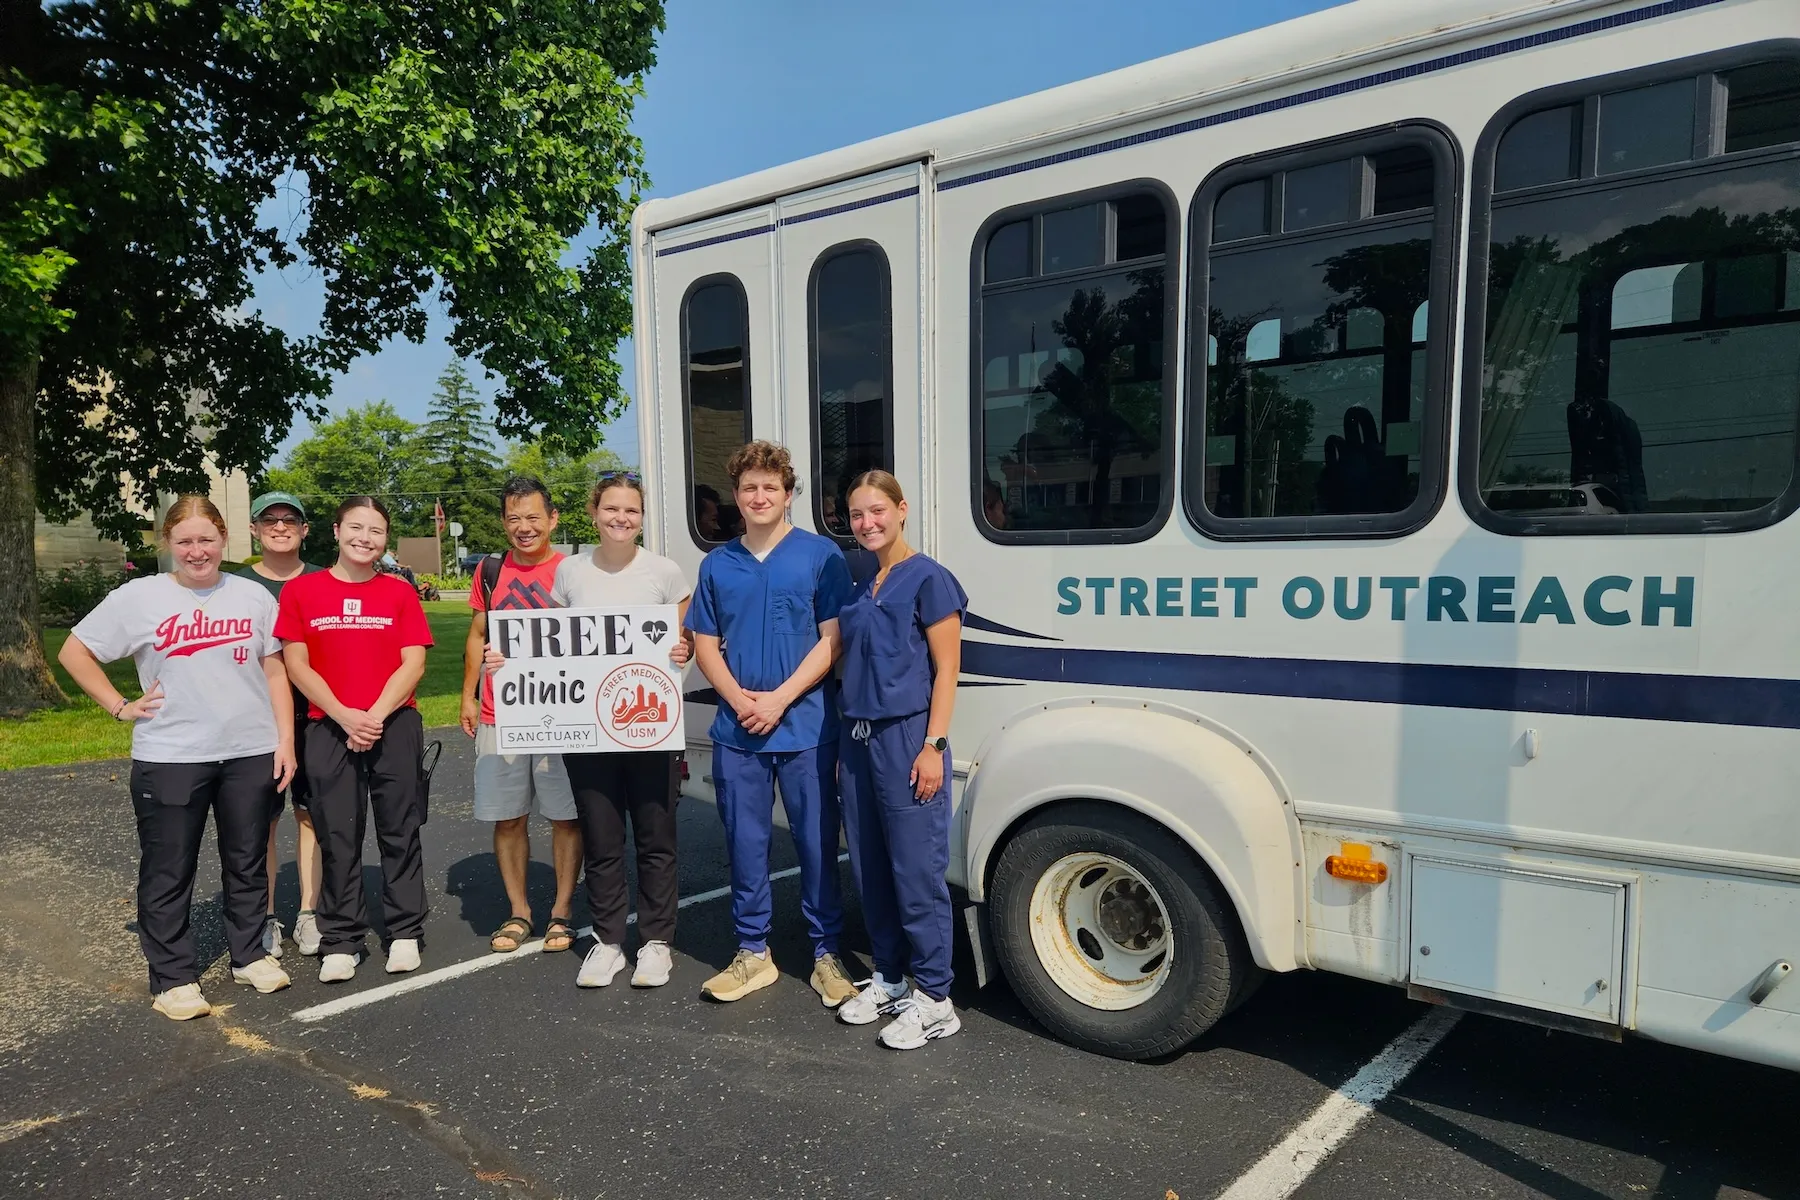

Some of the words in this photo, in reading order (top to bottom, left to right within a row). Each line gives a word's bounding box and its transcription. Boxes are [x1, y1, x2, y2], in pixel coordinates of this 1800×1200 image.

[1056, 576, 1258, 617] STREET
[1281, 575, 1695, 627] OUTREACH
[153, 608, 253, 651] Indiana
[310, 616, 342, 627] SCHOOL
[355, 616, 393, 625] MEDICINE
[495, 614, 633, 658] FREE
[501, 670, 585, 706] clinic
[602, 670, 629, 698] STREET
[631, 668, 672, 696] MEDICINE
[507, 730, 591, 742] SANCTUARY
[627, 727, 657, 738] IUSM
